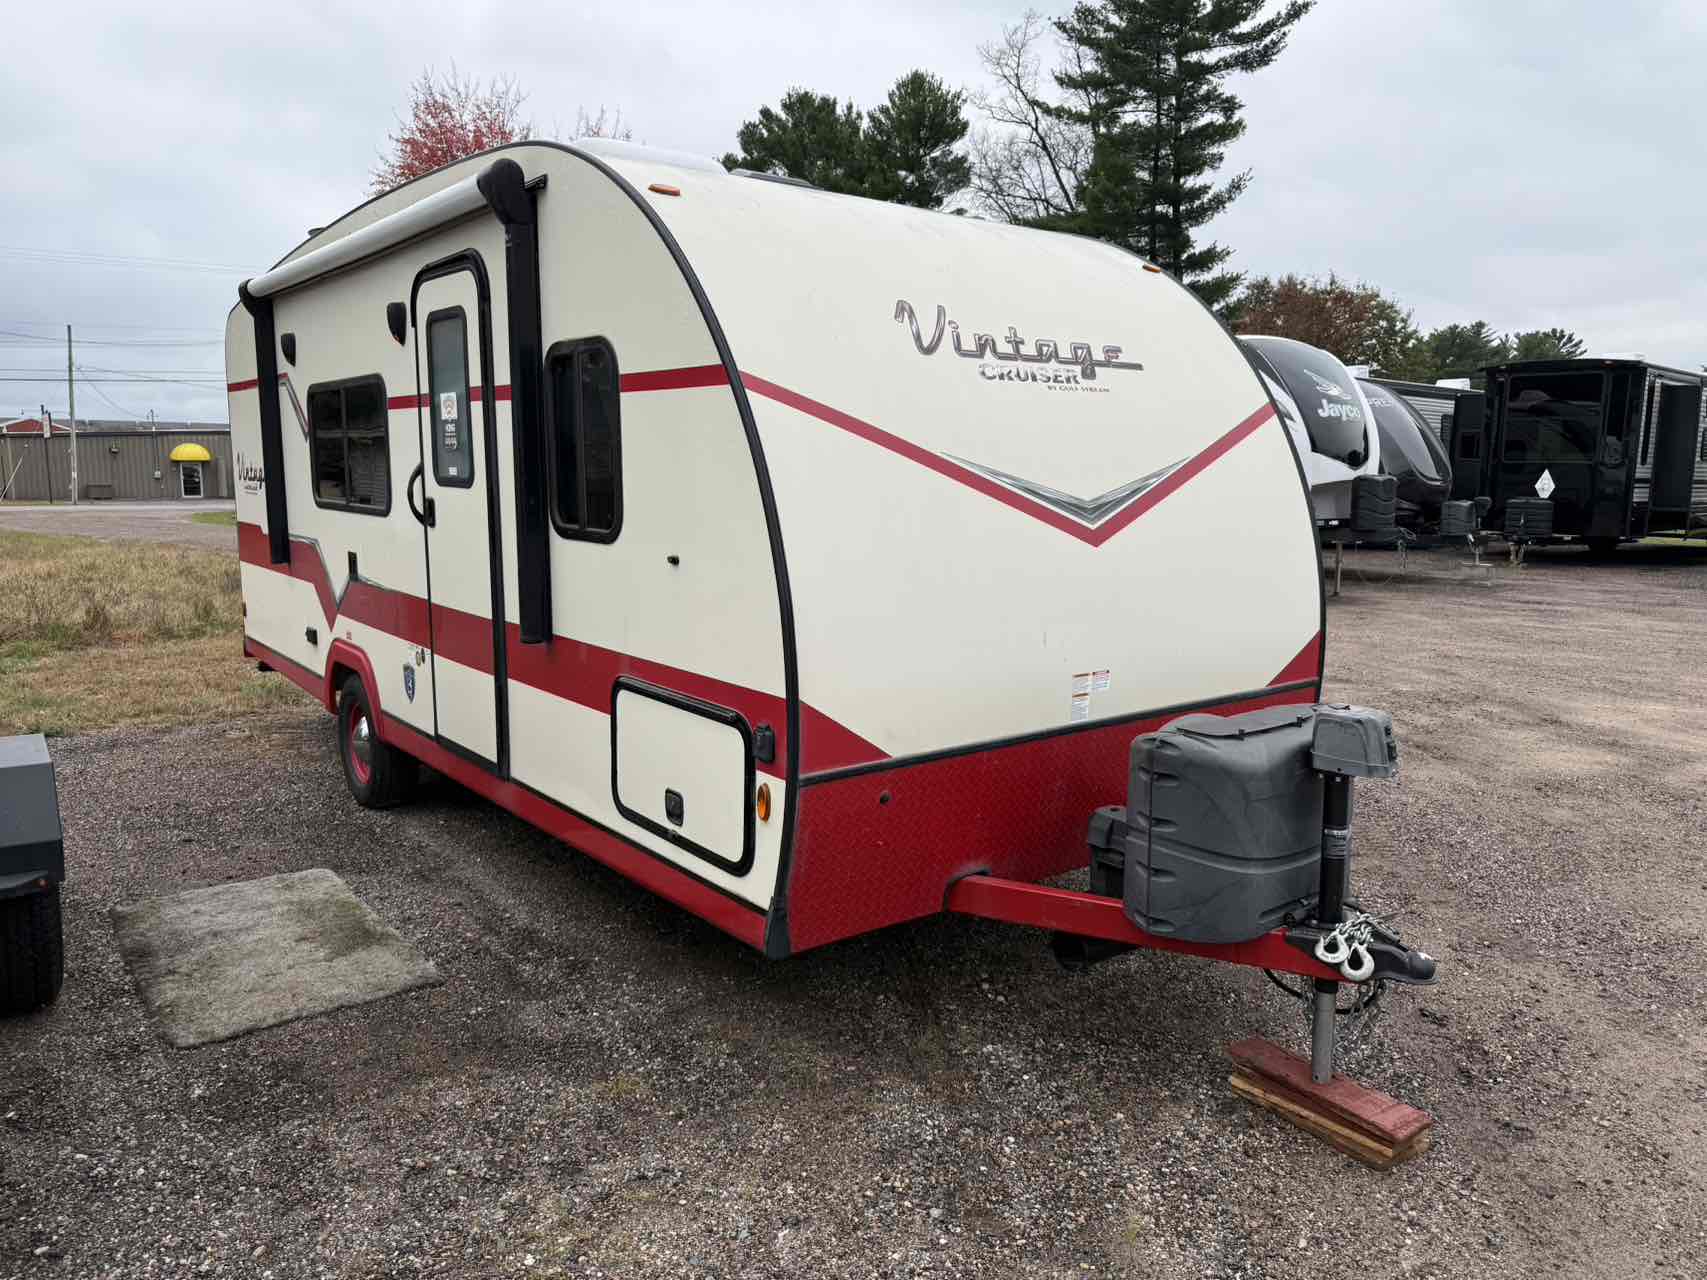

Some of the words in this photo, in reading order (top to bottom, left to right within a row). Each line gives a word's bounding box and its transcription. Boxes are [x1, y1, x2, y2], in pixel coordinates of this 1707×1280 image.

[894, 299, 1143, 380] Vintage
[978, 364, 1081, 384] CRUISER
[1317, 398, 1360, 421] Jayco
[236, 451, 264, 490] Vintag
